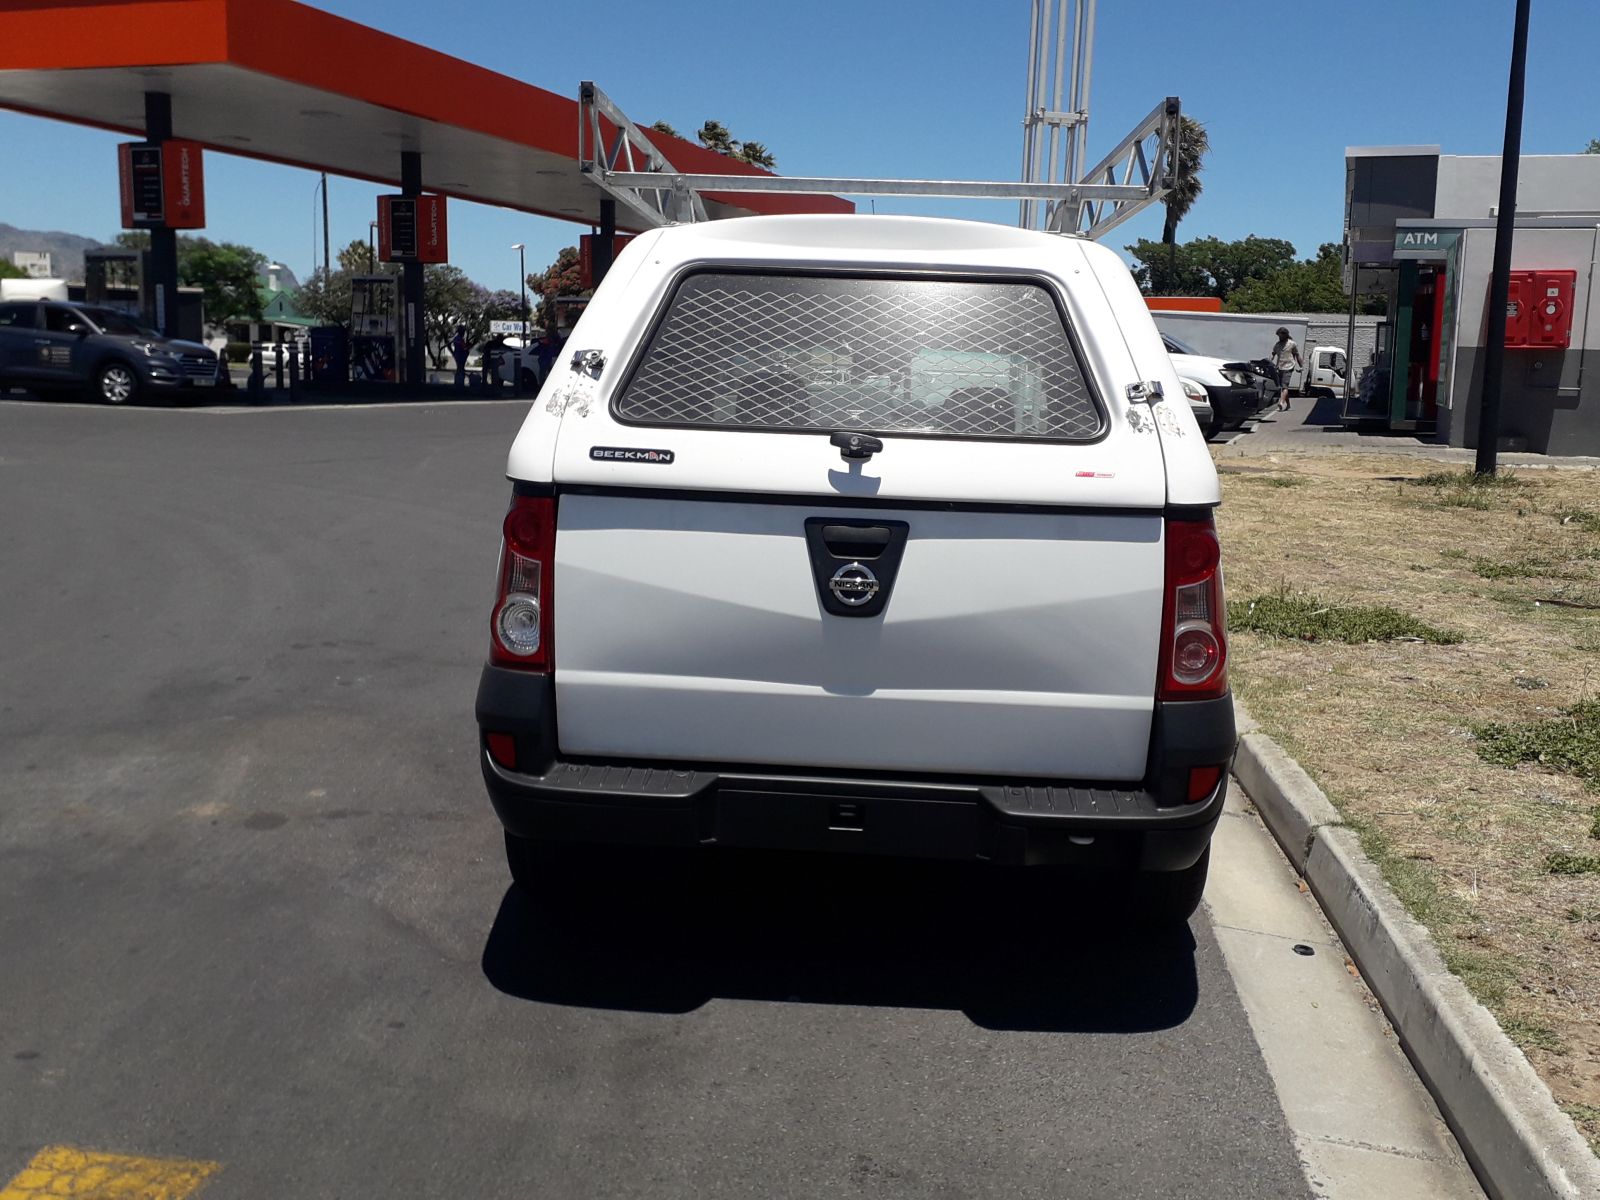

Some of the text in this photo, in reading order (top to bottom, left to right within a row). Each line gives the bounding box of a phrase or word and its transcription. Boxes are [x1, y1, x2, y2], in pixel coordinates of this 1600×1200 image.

[1403, 232, 1438, 245] ATM
[501, 322, 512, 331] Car
[593, 450, 671, 461] BEEKMAN
[834, 580, 874, 590] NISSAN
